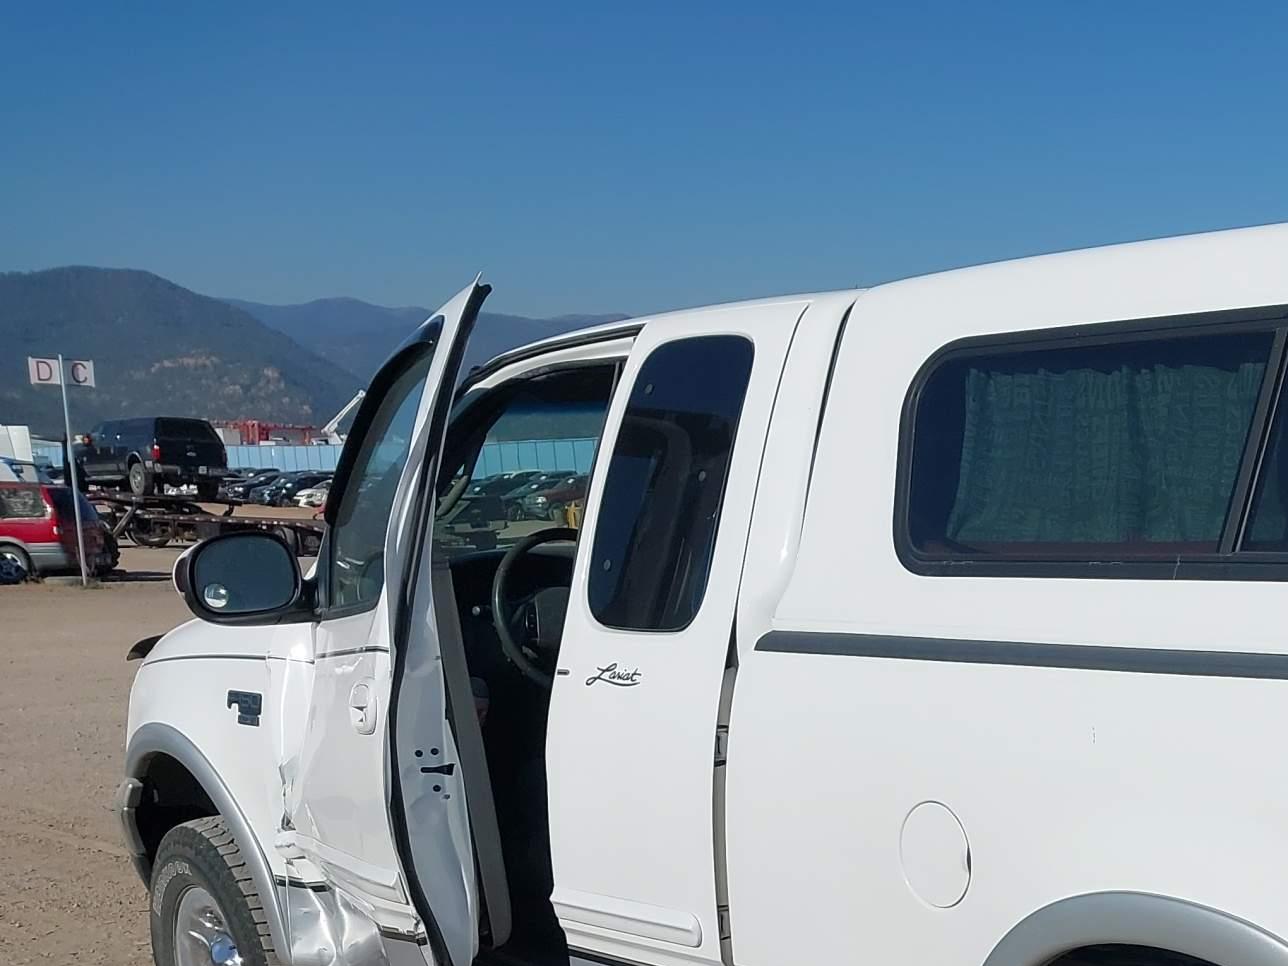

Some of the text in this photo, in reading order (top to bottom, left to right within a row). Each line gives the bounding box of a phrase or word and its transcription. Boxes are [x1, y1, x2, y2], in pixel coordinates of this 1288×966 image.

[36, 360, 88, 384] D C
[585, 662, 643, 687] Lariat
